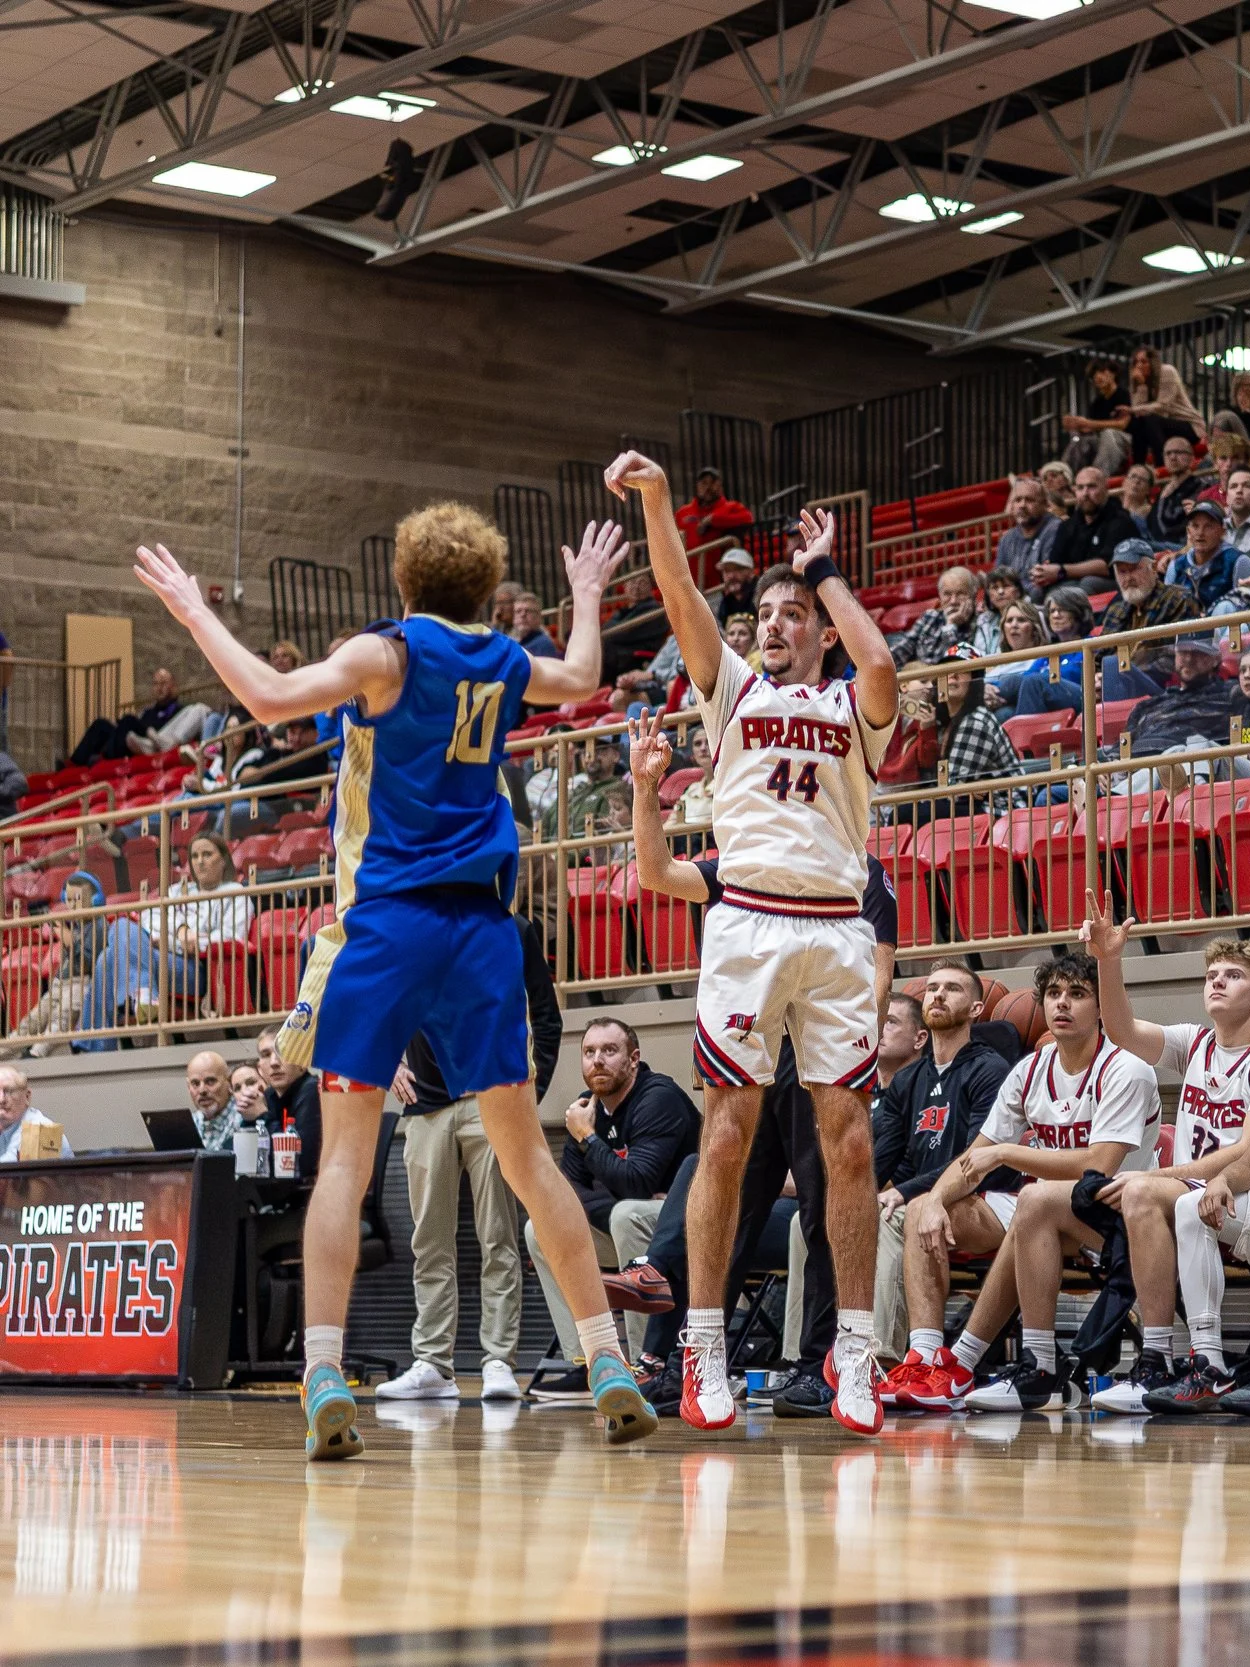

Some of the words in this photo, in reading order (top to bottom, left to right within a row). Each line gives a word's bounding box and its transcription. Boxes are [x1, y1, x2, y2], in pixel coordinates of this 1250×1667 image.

[445, 679, 505, 763] 10
[740, 716, 852, 758] PIRATES
[766, 757, 820, 803] 44
[1181, 1083, 1247, 1130] PIRATES
[21, 1205, 75, 1236] HOME
[77, 1202, 105, 1234] OF
[107, 1201, 145, 1233] THE
